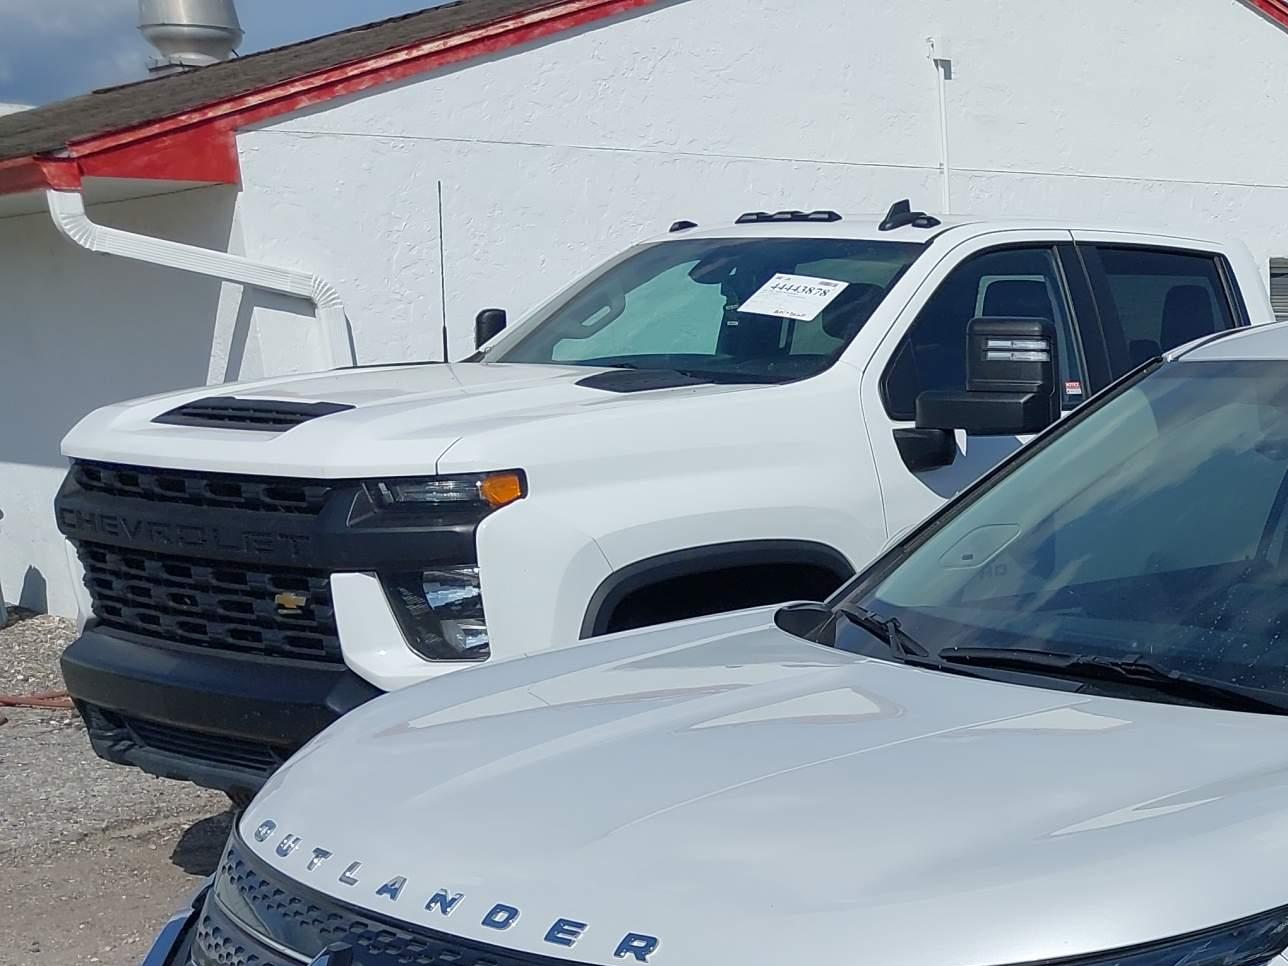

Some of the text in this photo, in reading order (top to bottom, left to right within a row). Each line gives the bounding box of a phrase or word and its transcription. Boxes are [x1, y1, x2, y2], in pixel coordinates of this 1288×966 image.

[770, 282, 831, 297] 44443878
[58, 507, 312, 558] CHEVROLET
[253, 818, 662, 965] OUTLANDER
